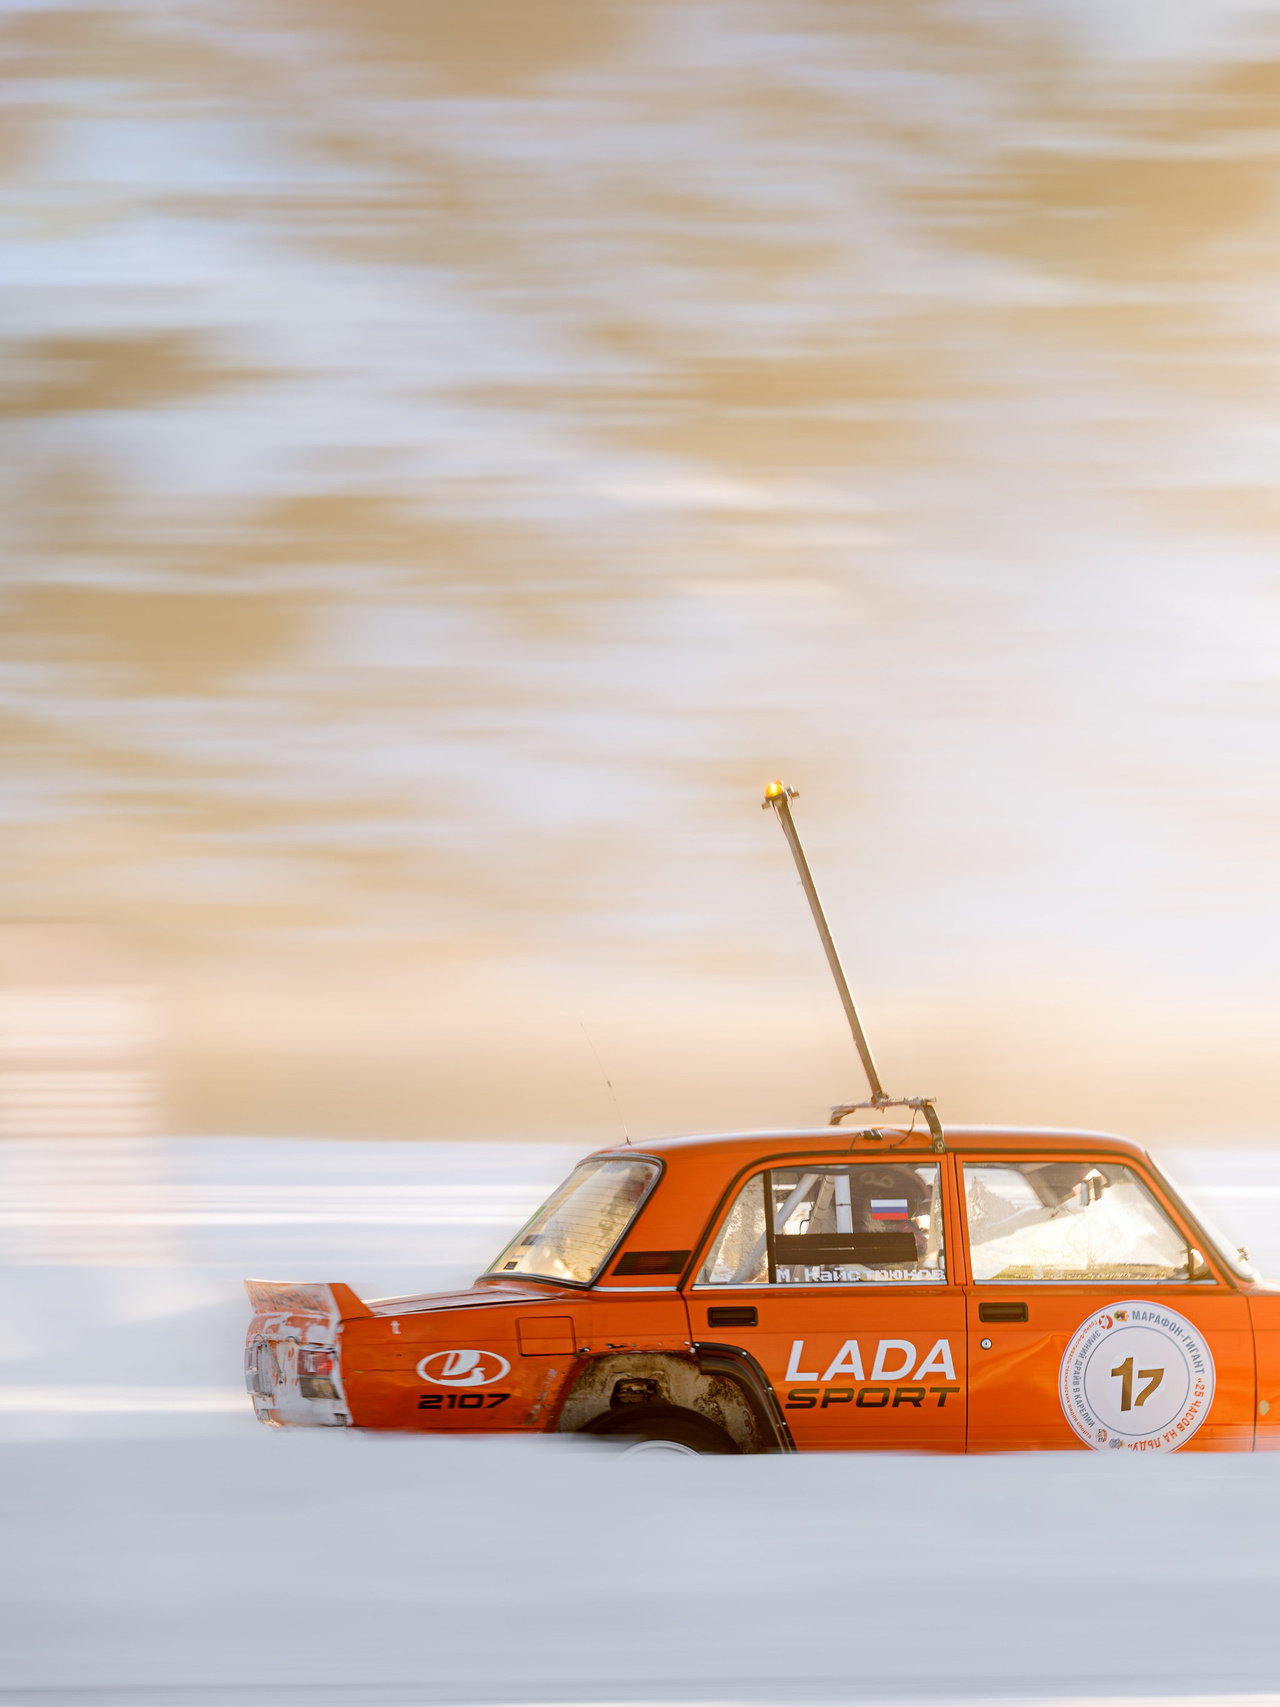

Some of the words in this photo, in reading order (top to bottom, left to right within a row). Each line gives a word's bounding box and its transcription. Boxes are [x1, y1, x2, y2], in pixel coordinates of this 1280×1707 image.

[776, 1268, 800, 1283] М.
[1078, 1330, 1101, 1360] ЗИМНИЙ
[1132, 1310, 1205, 1374] МАРАФОН-ГИГАНТ
[784, 1339, 957, 1382] LADA
[1072, 1359, 1083, 1386] ДРАЙВ
[1111, 1356, 1165, 1412] 17
[1194, 1377, 1205, 1397] «25
[417, 1393, 511, 1409] 2107
[784, 1387, 961, 1409] SPORT
[1074, 1394, 1096, 1428] КАРЕЛИИ
[1176, 1400, 1202, 1432] ЧАСОВ
[1127, 1437, 1161, 1452] ЛЬДУ»
[1162, 1428, 1178, 1443] НА
